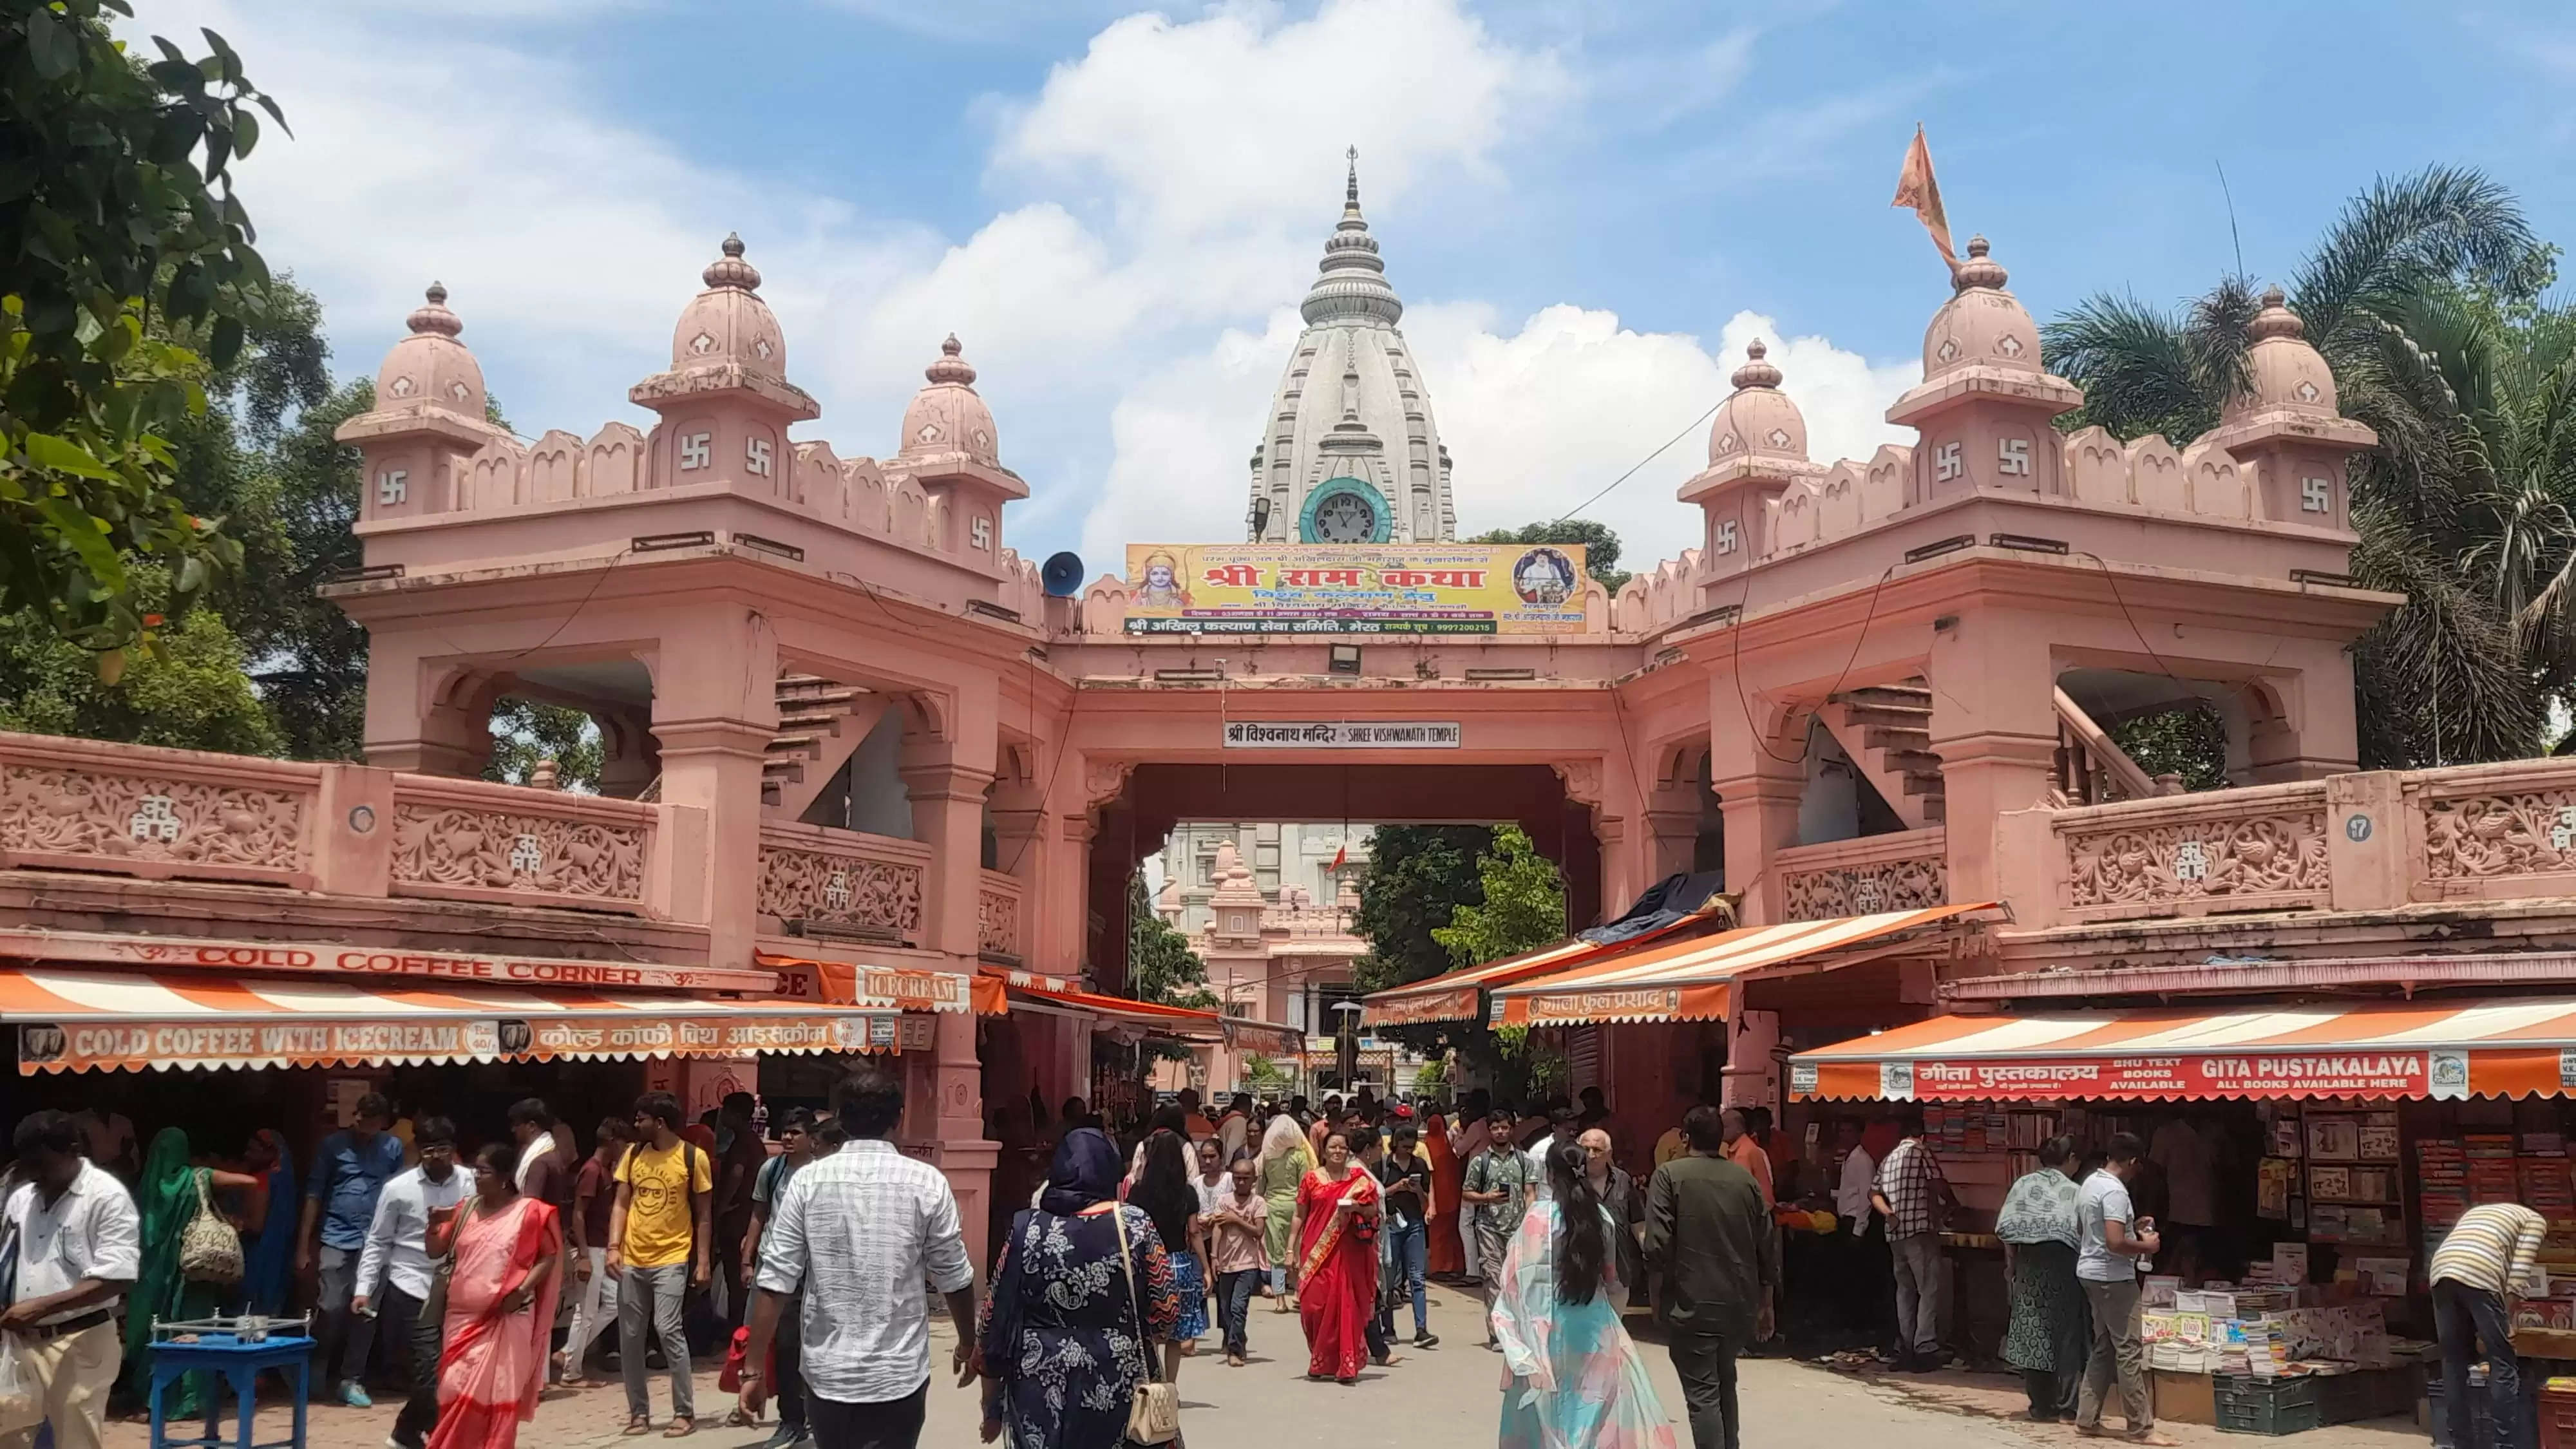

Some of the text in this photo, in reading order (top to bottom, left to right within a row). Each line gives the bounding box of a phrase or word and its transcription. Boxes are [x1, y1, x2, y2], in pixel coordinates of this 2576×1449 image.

[1360, 509, 1367, 518] 2
[1319, 519, 1326, 527] 9
[1323, 528, 1331, 538] 8
[1361, 529, 1368, 538] 4
[1202, 564, 1264, 587] श्री
[1280, 569, 1364, 587] राम
[1128, 618, 1148, 631] श्री
[1151, 618, 1201, 631] अखिल
[1204, 621, 1256, 631] कल्याण
[1260, 620, 1288, 631] सेवा
[1349, 620, 1381, 632] मेरठ
[1228, 724, 1336, 744] श्री विश्वनाथ मन्दिर
[1348, 728, 1457, 742] SHREE VISHWANATH TEMPLE
[2351, 819, 2367, 838] 17
[196, 947, 642, 984] COLD COFFEE CORNER
[868, 973, 955, 1001] ICECREAM
[1611, 989, 1663, 1009] प्रसाद
[75, 1025, 459, 1056] COLD COFFEE WITH ICECREAM
[539, 1023, 605, 1048] कोल्ड
[679, 1022, 719, 1045] विथ
[2146, 1058, 2183, 1067] TEXT
[2201, 1056, 2421, 1078] GITA PUSTAKALAYA
[1919, 1063, 2099, 1088] गीता पुस्तकालय
[2123, 1070, 2172, 1079] BOOKS
[2110, 1080, 2186, 1090] AVAILABLE
[2216, 1077, 2408, 1090] ALL BOOKS AVAILABLE HERE
